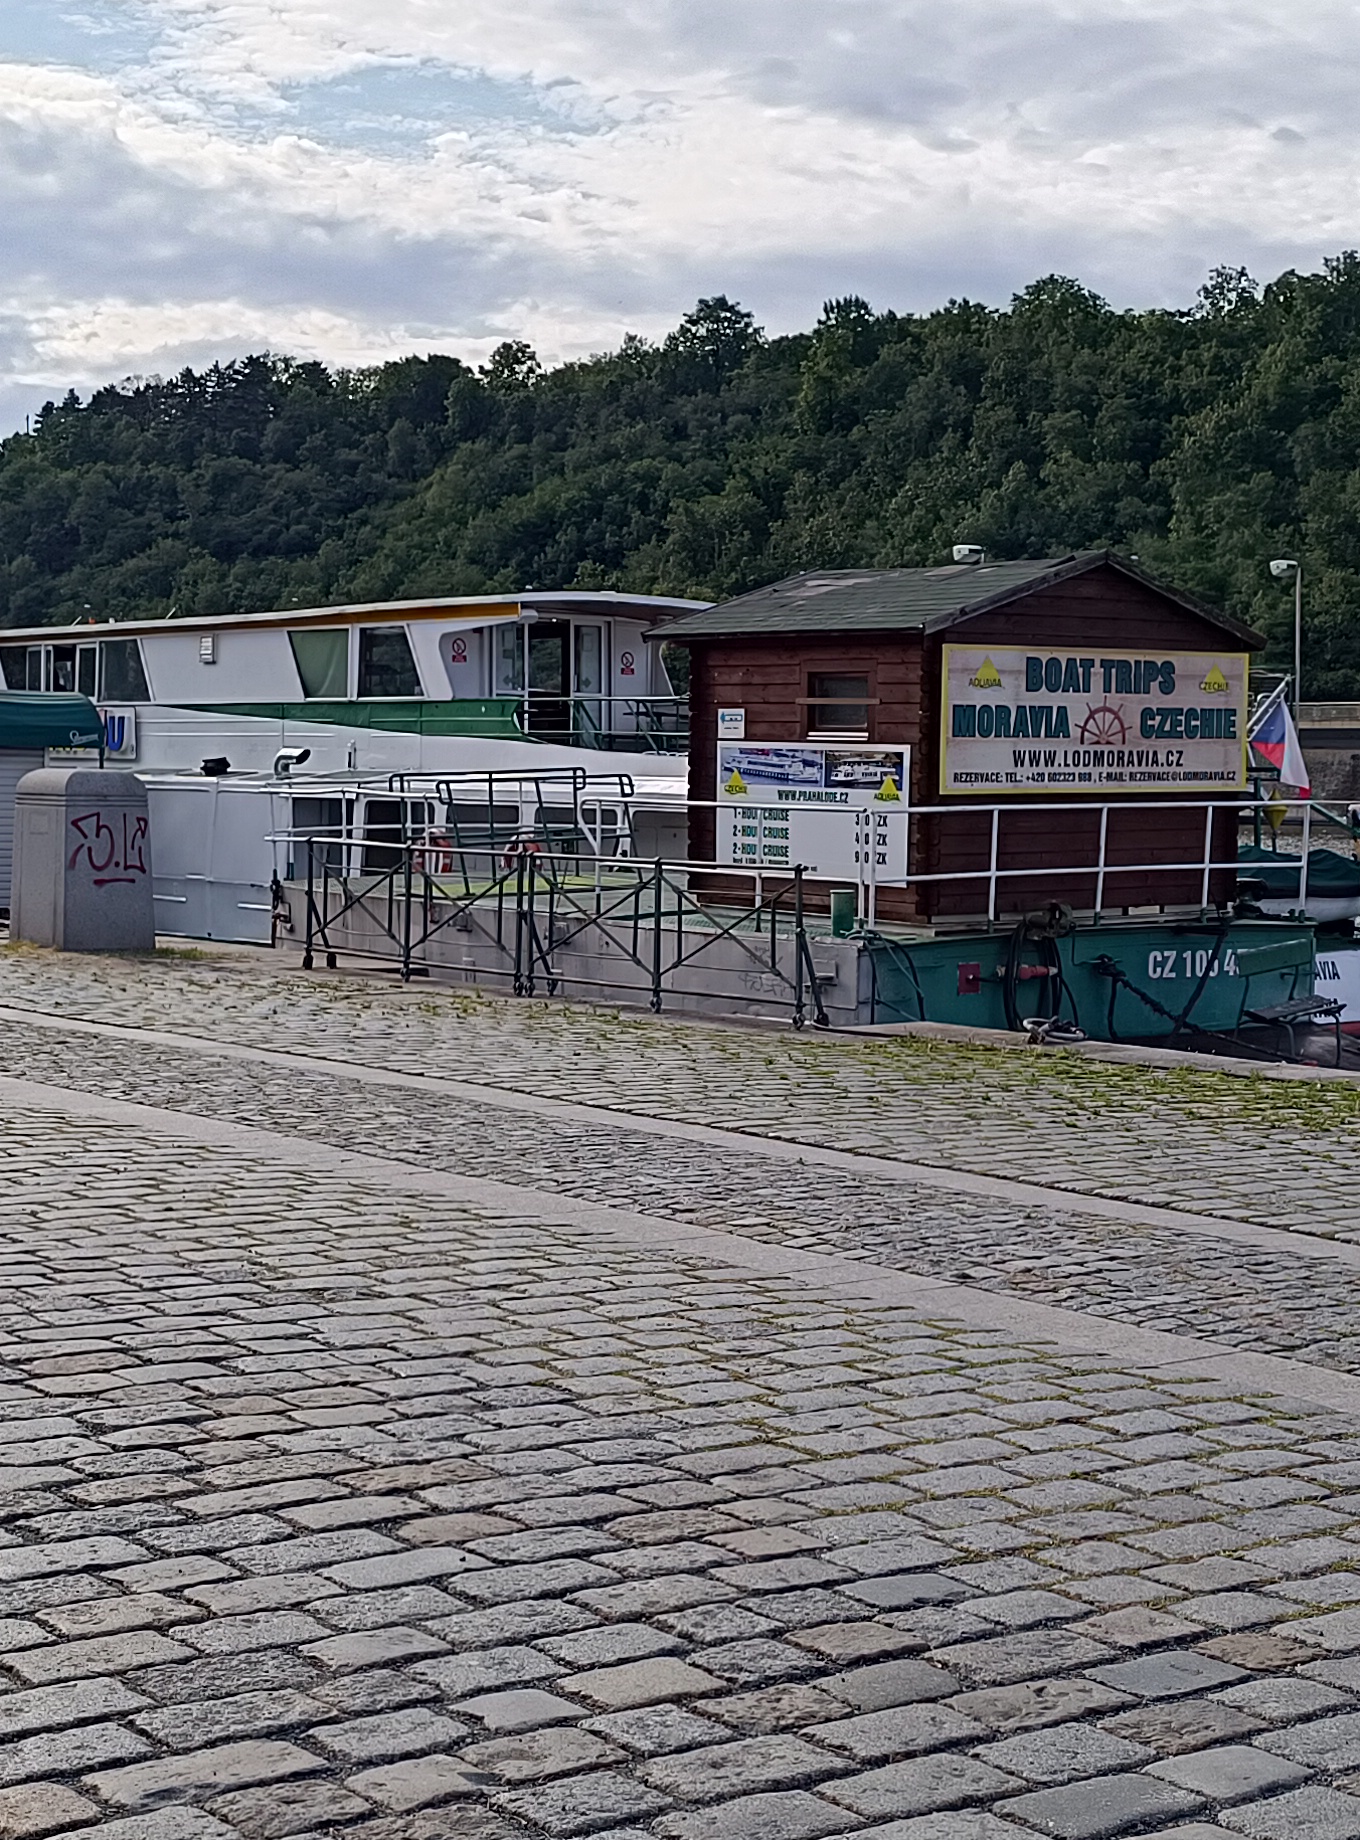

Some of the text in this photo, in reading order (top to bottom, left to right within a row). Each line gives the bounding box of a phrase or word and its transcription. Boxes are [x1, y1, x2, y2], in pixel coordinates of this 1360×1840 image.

[1026, 656, 1175, 695] BOAT TRIPS
[952, 704, 1237, 740] MORAVIA CZECHIE
[1012, 749, 1184, 768] WWW.LODMORAVIA.CZ
[953, 772, 1003, 783] REZERVACE:
[1099, 771, 1127, 782] E-MAIL:
[1129, 771, 1236, 782] REZERVACE@LODMORAVIA.CZ
[763, 808, 789, 821] CRUISE
[855, 813, 870, 826] 30
[732, 824, 759, 837] 2-HOU
[763, 826, 789, 840] CRUISE
[854, 832, 870, 845] 40
[732, 842, 758, 855] 2-HOU
[762, 844, 789, 858] CRUISE
[854, 850, 870, 864] 90
[1148, 950, 1176, 979] CZ
[1223, 949, 1239, 976] 4
